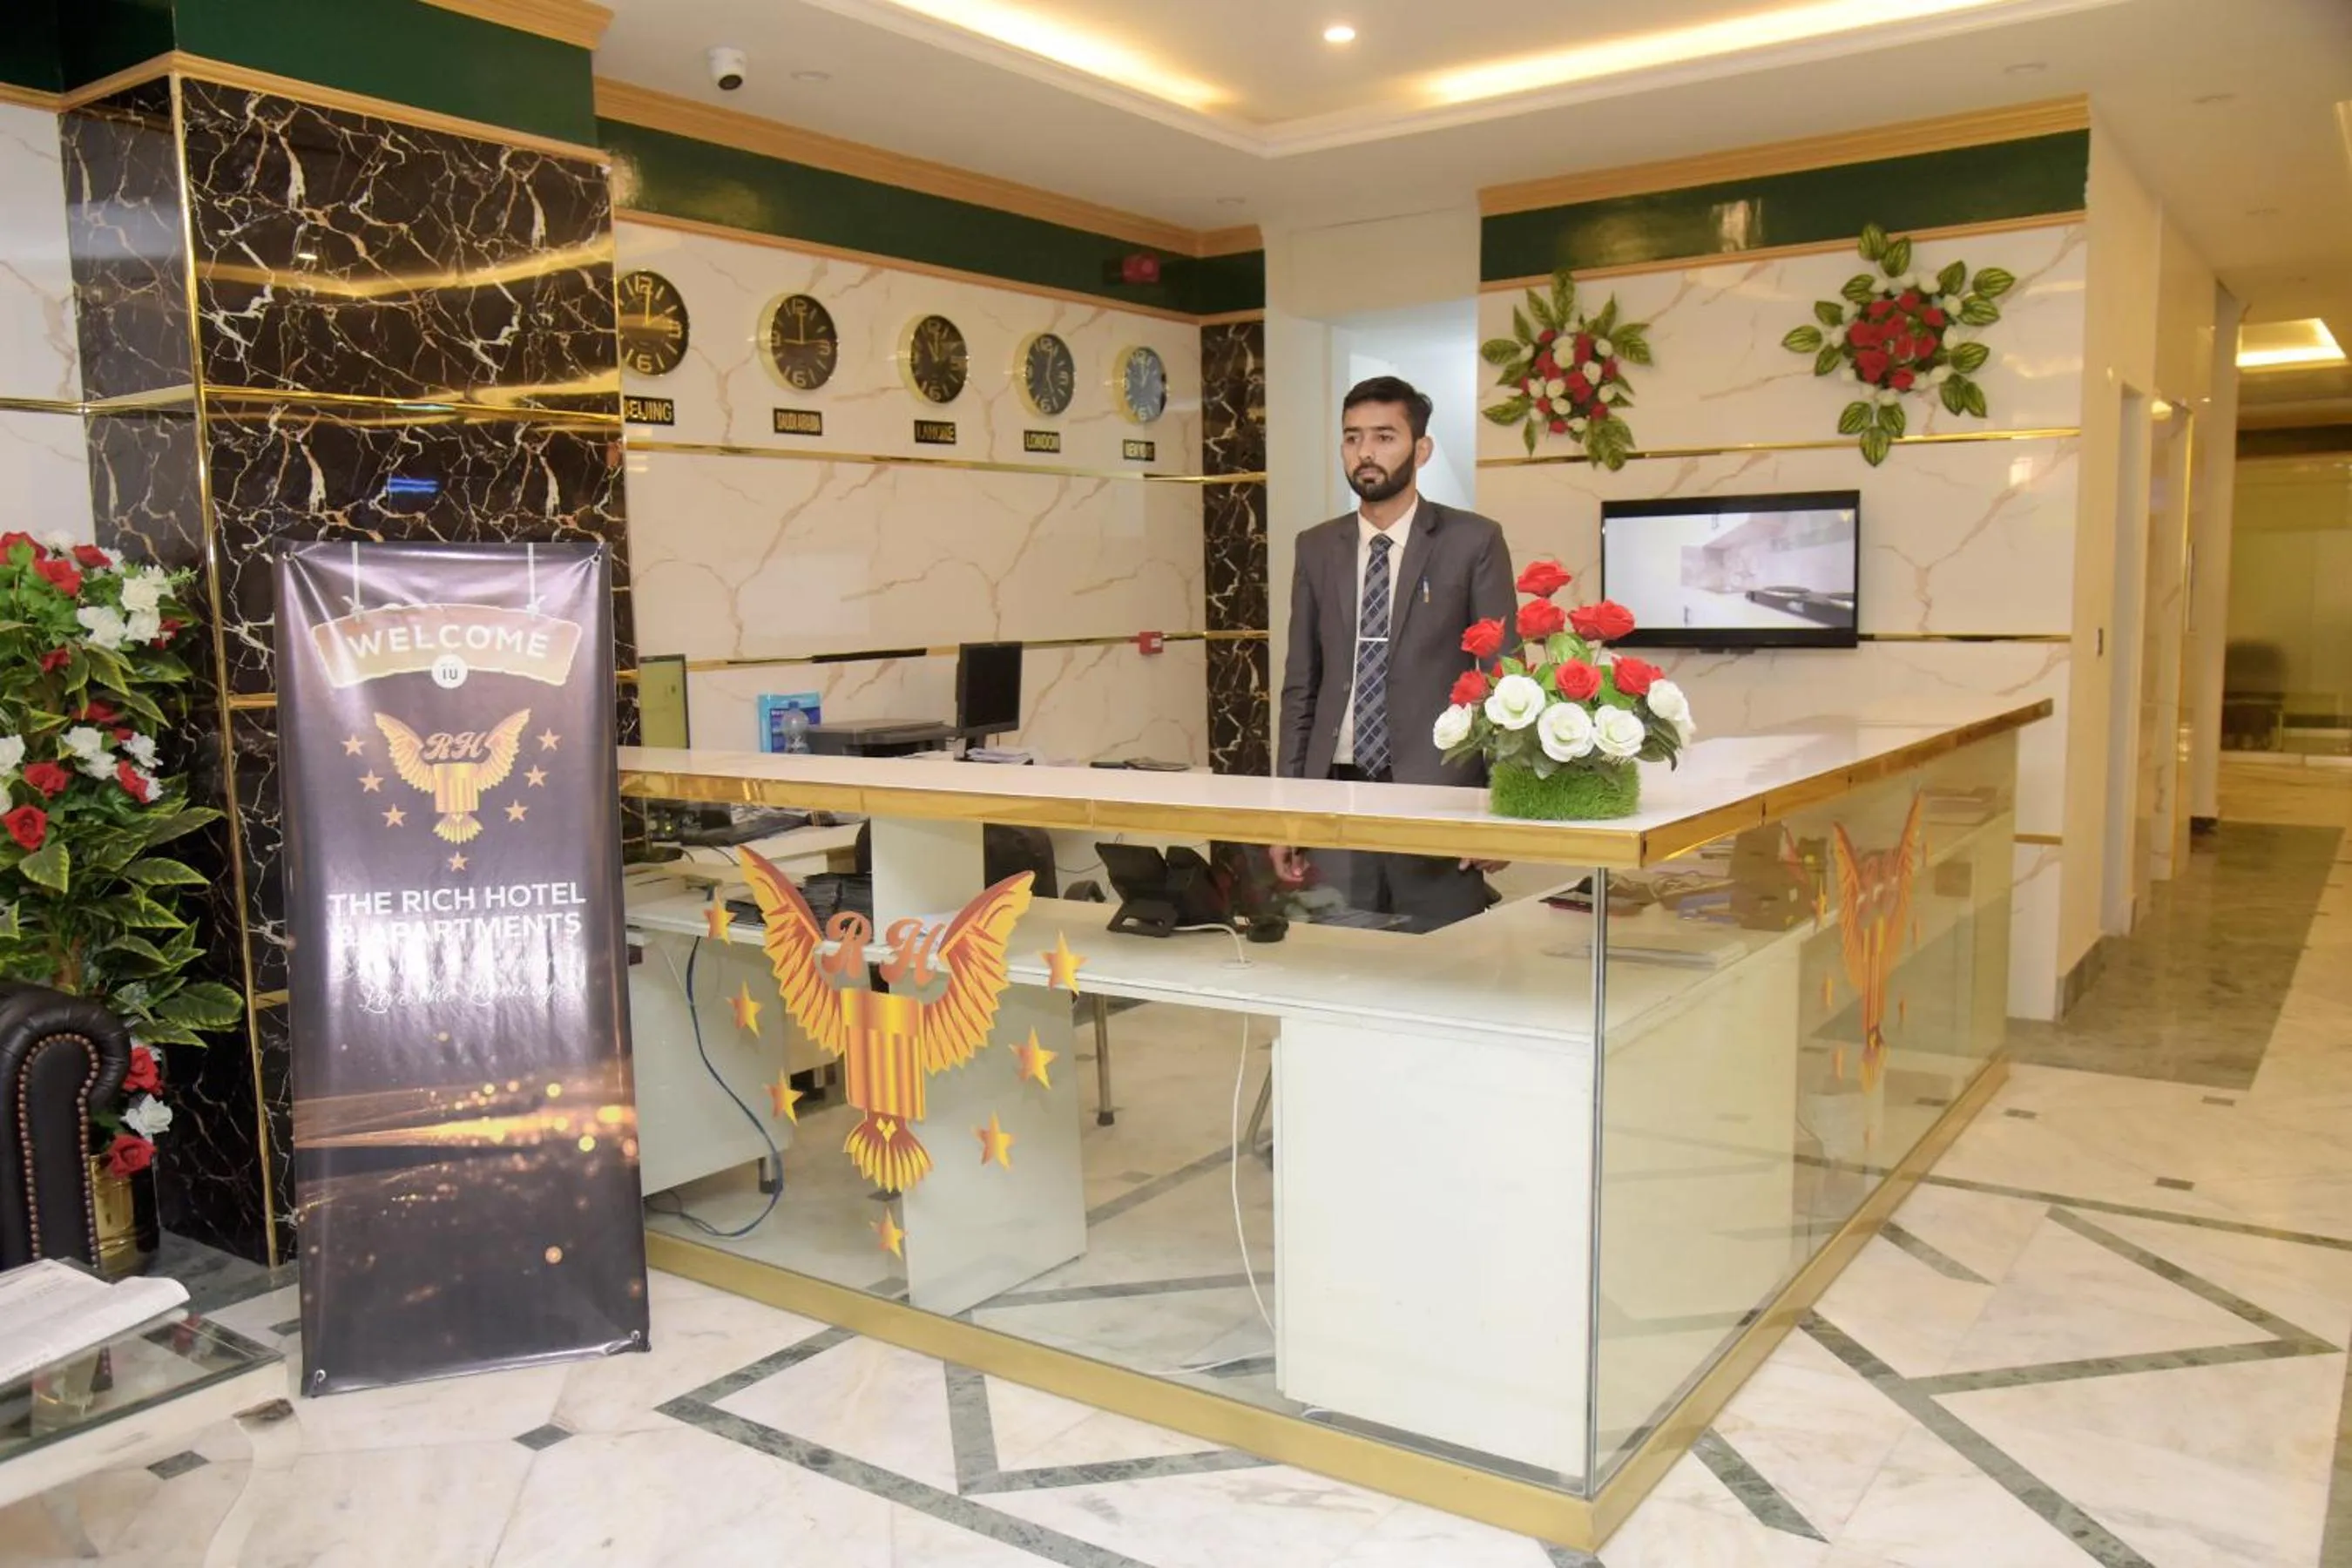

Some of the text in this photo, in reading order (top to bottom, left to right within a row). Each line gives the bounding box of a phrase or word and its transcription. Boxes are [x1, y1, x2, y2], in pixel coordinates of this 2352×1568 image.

[637, 354, 652, 372] 6
[792, 370, 806, 387] 6
[346, 624, 551, 659] WELCOME
[327, 882, 586, 916] THE RICH HOTEL
